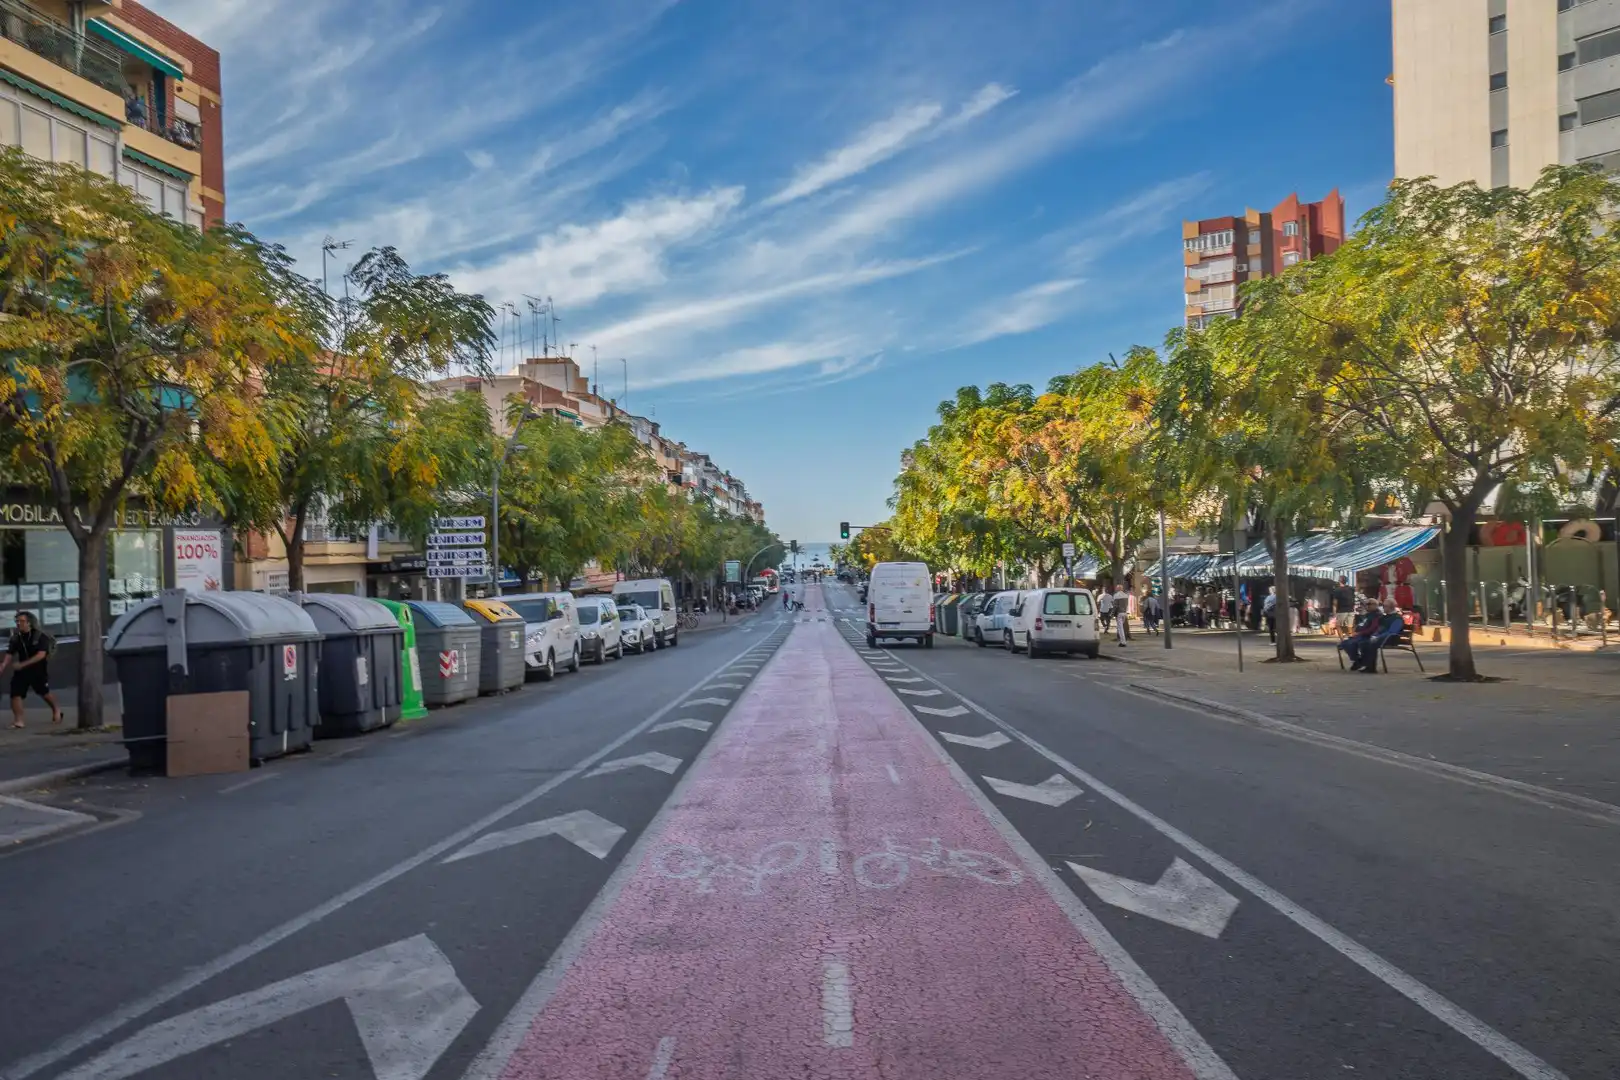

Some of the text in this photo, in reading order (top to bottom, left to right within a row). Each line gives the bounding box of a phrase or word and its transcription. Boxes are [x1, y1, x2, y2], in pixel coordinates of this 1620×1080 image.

[428, 535, 482, 544] BENIDORM
[177, 544, 218, 559] 100%
[428, 551, 483, 560] BENIDORM
[428, 567, 483, 576] BENIDORM
